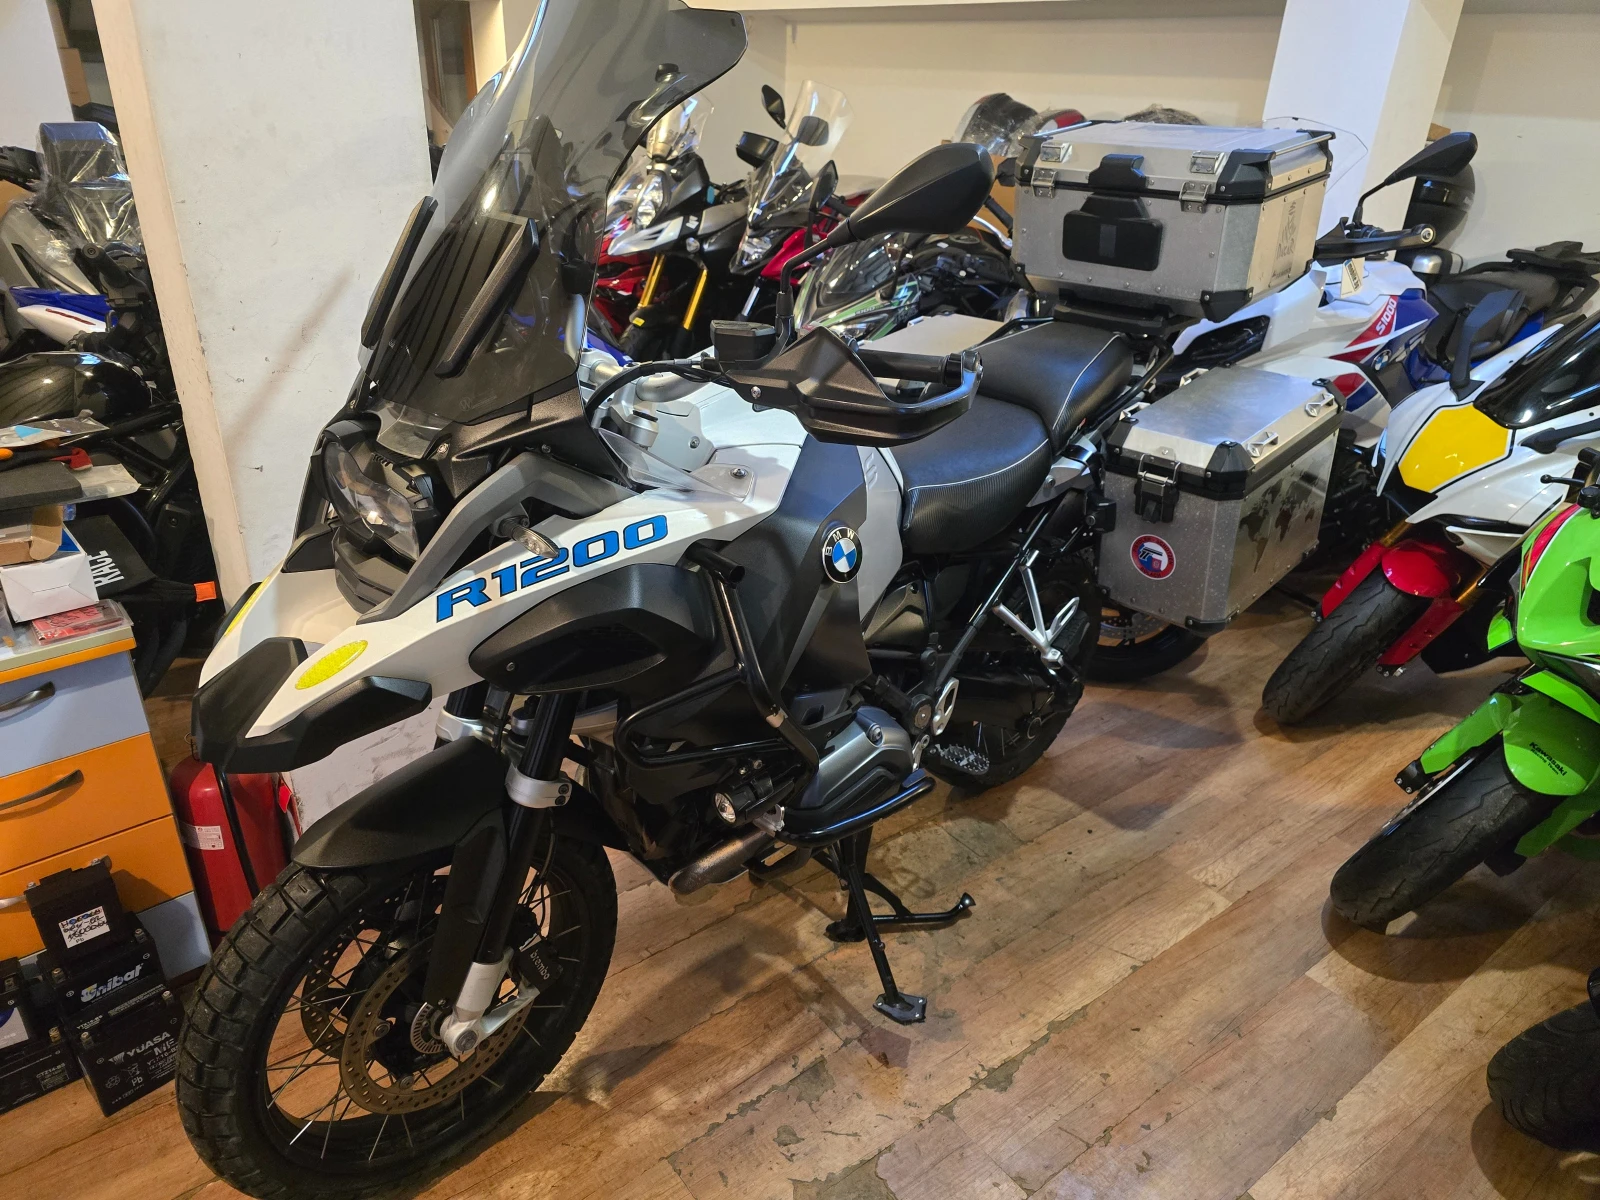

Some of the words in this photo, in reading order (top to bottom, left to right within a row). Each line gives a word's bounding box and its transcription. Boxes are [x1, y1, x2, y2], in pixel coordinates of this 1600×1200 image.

[1376, 297, 1397, 335] S1000
[436, 514, 669, 624] R1200
[1529, 741, 1568, 776] Kawasaki
[530, 949, 550, 980] brembo
[80, 964, 144, 1003] Unibat
[126, 1031, 171, 1057] YUASA
[131, 1076, 143, 1087] Pb
